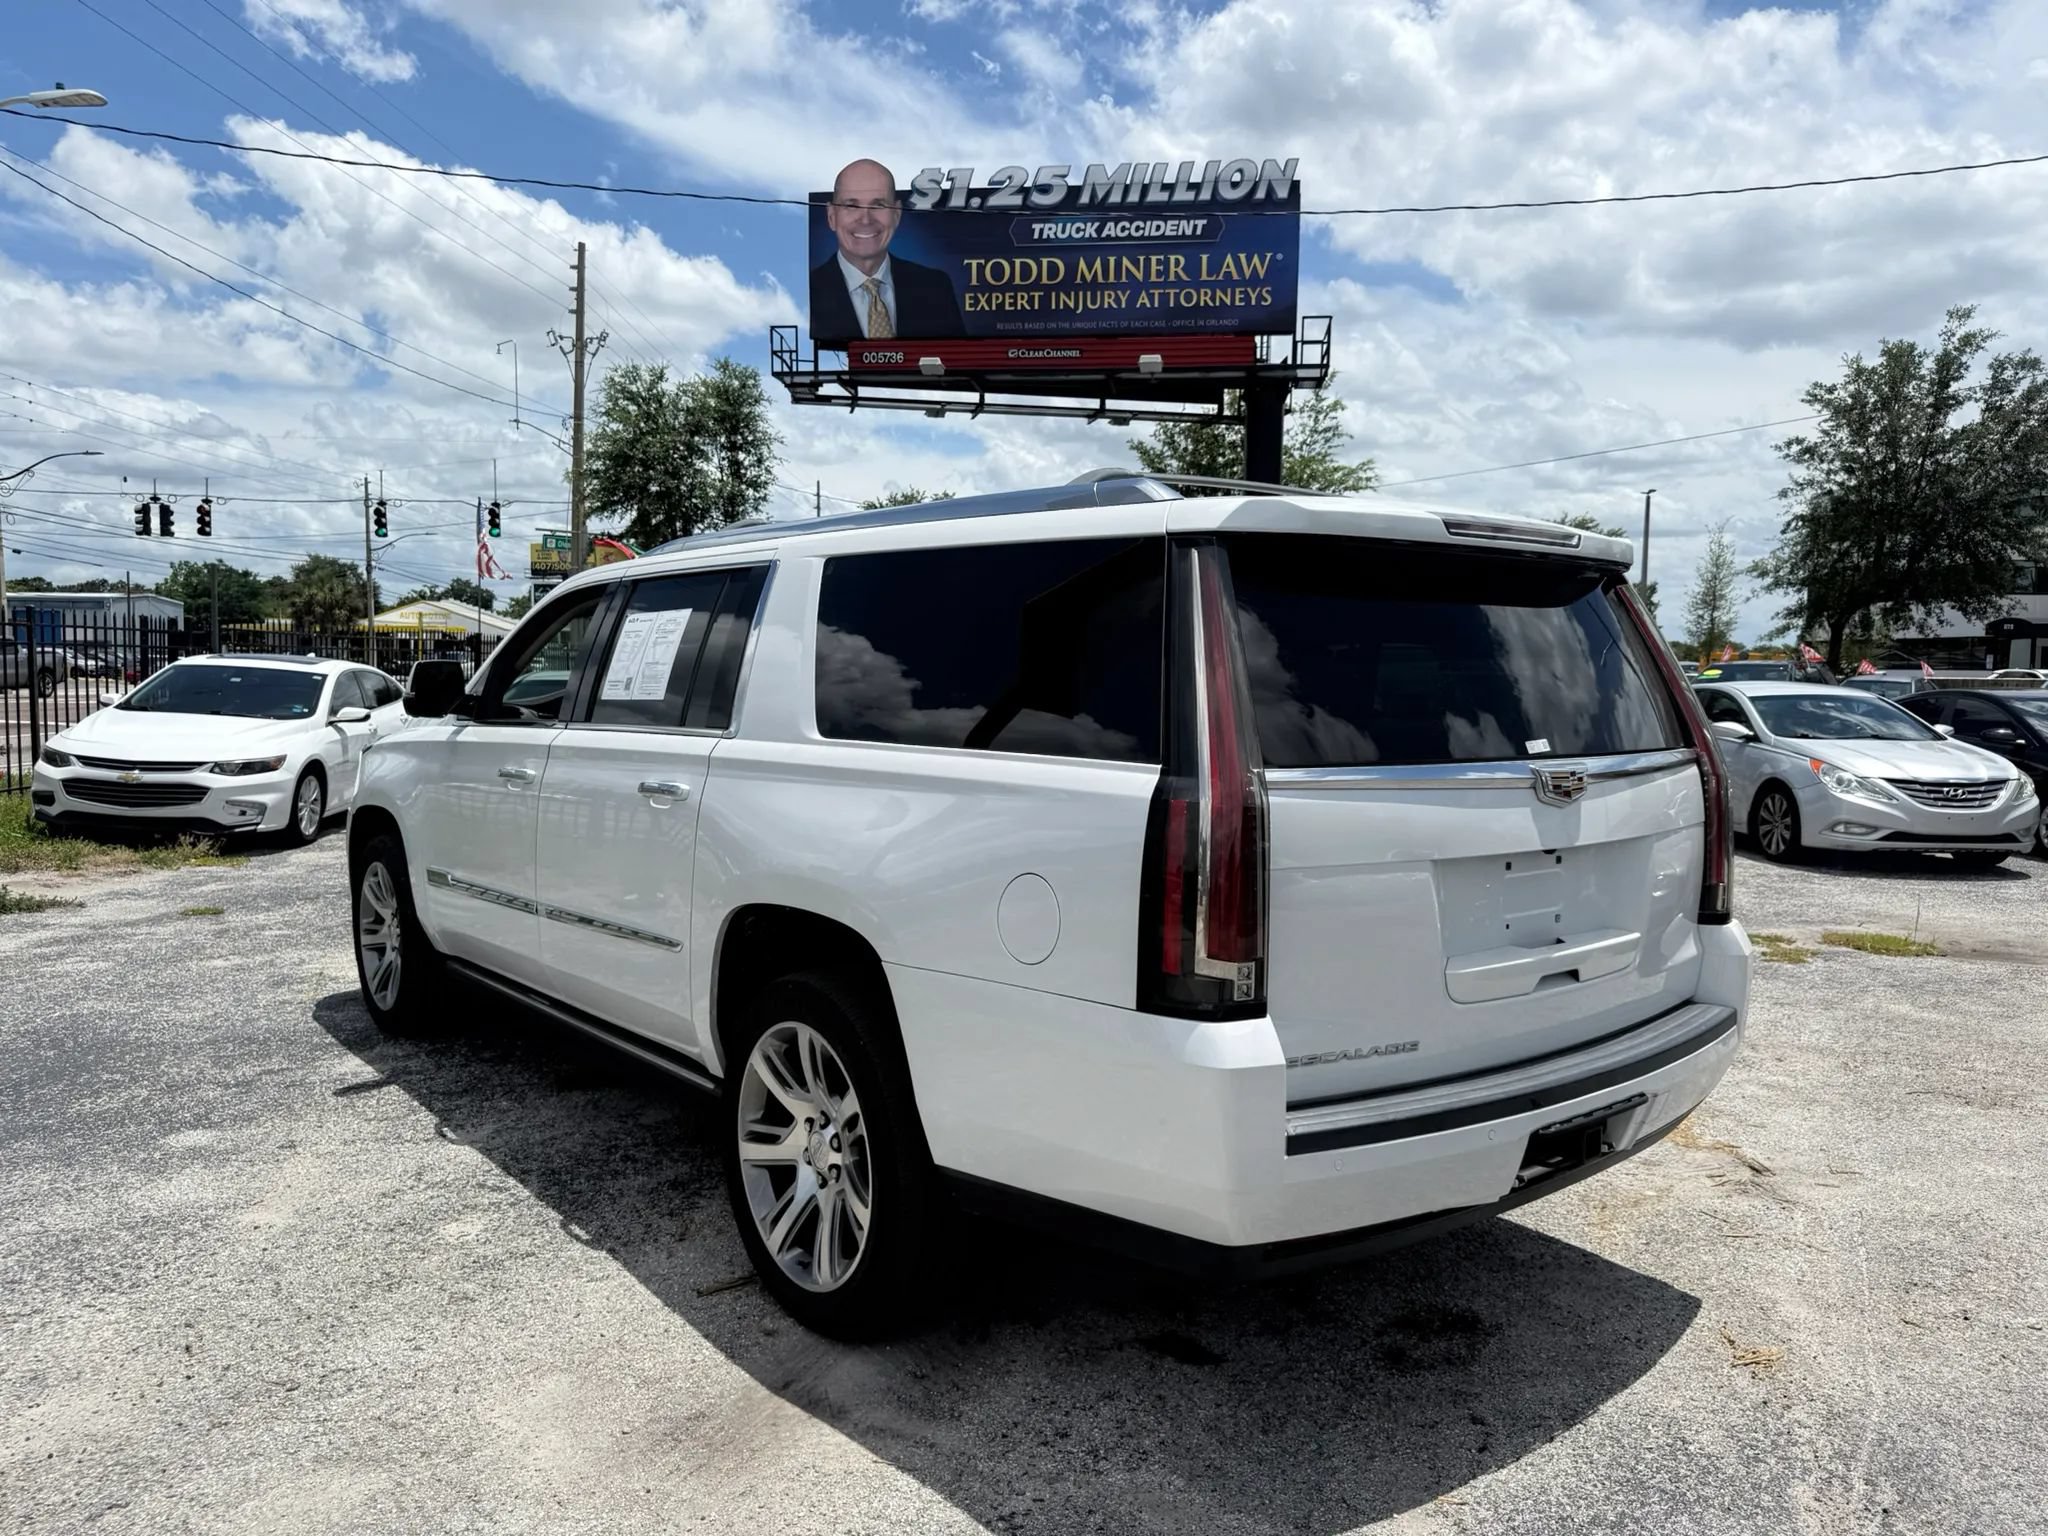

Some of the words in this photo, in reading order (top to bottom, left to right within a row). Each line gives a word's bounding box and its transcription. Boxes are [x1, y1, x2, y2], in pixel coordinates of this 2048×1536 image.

[909, 165, 1072, 210] $1.25
[1077, 158, 1299, 206] MILLION
[1031, 222, 1100, 239] TRUCK
[1101, 219, 1207, 238] ACCIDENT
[963, 257, 1065, 286] TODD
[1074, 254, 1191, 284] MINER
[964, 291, 1044, 311] EXPERT
[1051, 289, 1131, 314] INJURY
[1136, 287, 1272, 308] ATTORNEYS
[996, 322, 1023, 330] RESULTS
[1046, 321, 1057, 329] ON
[1058, 321, 1070, 329] THE
[1072, 321, 1097, 329] UNIQUE
[1098, 320, 1119, 329] FACTS
[1120, 320, 1129, 328] OF
[1130, 320, 1148, 328] EACH
[1149, 320, 1167, 328] CASE
[1172, 319, 1195, 327] OFFICE
[1205, 318, 1239, 326] ORLANDO
[863, 352, 904, 363] 005736
[1286, 1041, 1419, 1068] ESCALADE
